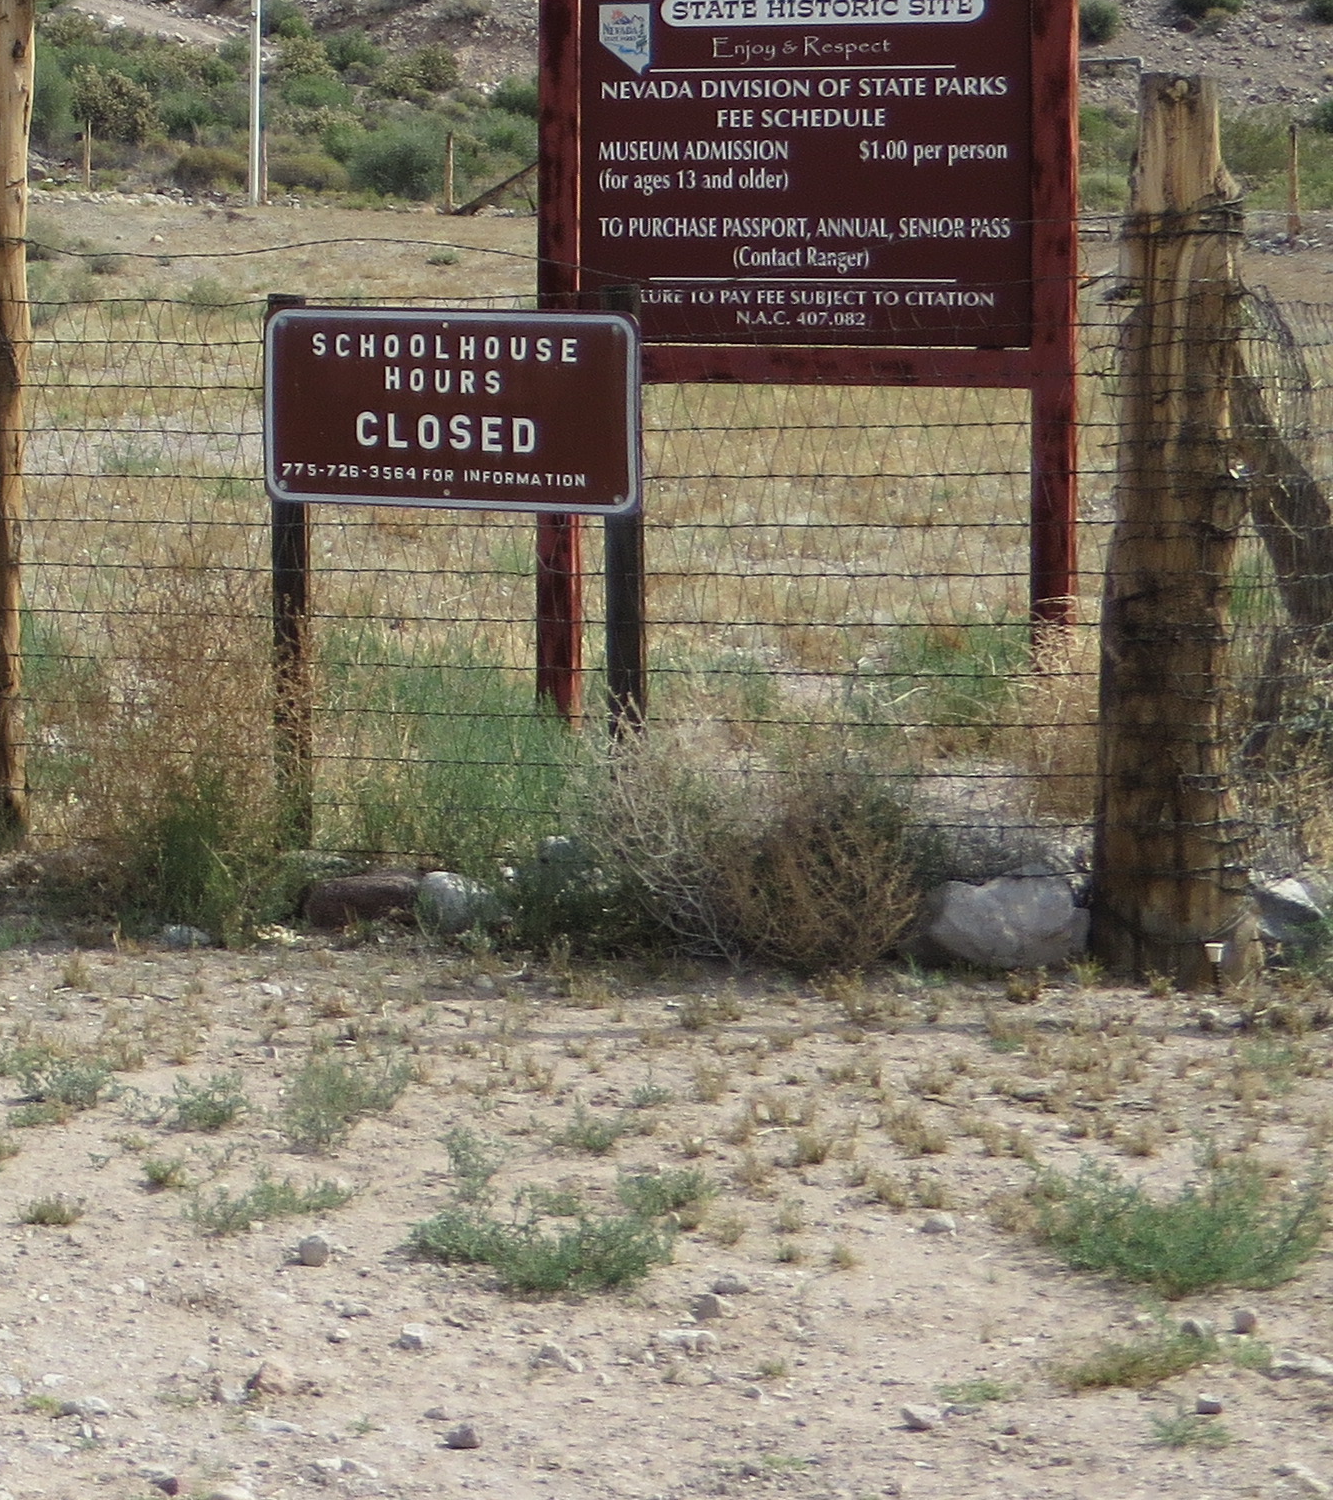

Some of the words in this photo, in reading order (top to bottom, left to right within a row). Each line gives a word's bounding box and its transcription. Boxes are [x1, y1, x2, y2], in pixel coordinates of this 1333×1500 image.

[672, 0, 758, 21] STATE
[712, 36, 776, 65] Enjoy
[782, 39, 798, 54] &
[803, 35, 891, 61] Respect
[601, 80, 694, 100] NEVADA
[701, 78, 810, 99] DIVISION
[817, 78, 851, 98] OF
[858, 77, 926, 97] STATE
[934, 76, 1008, 96] PARKS
[717, 109, 754, 128] FEE
[761, 108, 886, 128] SCHEDULE
[598, 140, 679, 161] MUSEUM
[684, 139, 789, 161] ADMISSION
[859, 140, 908, 162] $1.00
[913, 145, 943, 167] per
[947, 140, 1008, 167] person
[599, 168, 629, 192] (for
[633, 174, 671, 196] ages
[677, 169, 696, 189] 13
[703, 167, 733, 189] and
[738, 167, 789, 191] older)
[598, 217, 624, 238] TO
[628, 217, 717, 238] PURCHASE
[722, 217, 811, 241] PASSPORT,
[815, 217, 894, 241] ANNUAL,
[899, 217, 965, 238] SENIOR
[971, 217, 1011, 238] PASS
[733, 245, 802, 269] (Contact
[807, 245, 870, 273] Ranger)
[690, 290, 715, 304] TO
[720, 289, 752, 305] PAY
[757, 289, 785, 305] FEE
[790, 290, 866, 307] SUBJECT
[874, 290, 900, 306] TO
[905, 291, 994, 307] CITATION
[736, 310, 791, 326] N.A.C.
[796, 311, 866, 327] 407.082
[312, 332, 578, 363] SCHOOLHOUSE
[385, 366, 501, 395] HOURS
[356, 411, 536, 453] CLOSED
[281, 462, 416, 481] 775-726-3564
[422, 468, 454, 482] FOR
[464, 469, 586, 487] INFORMATION
